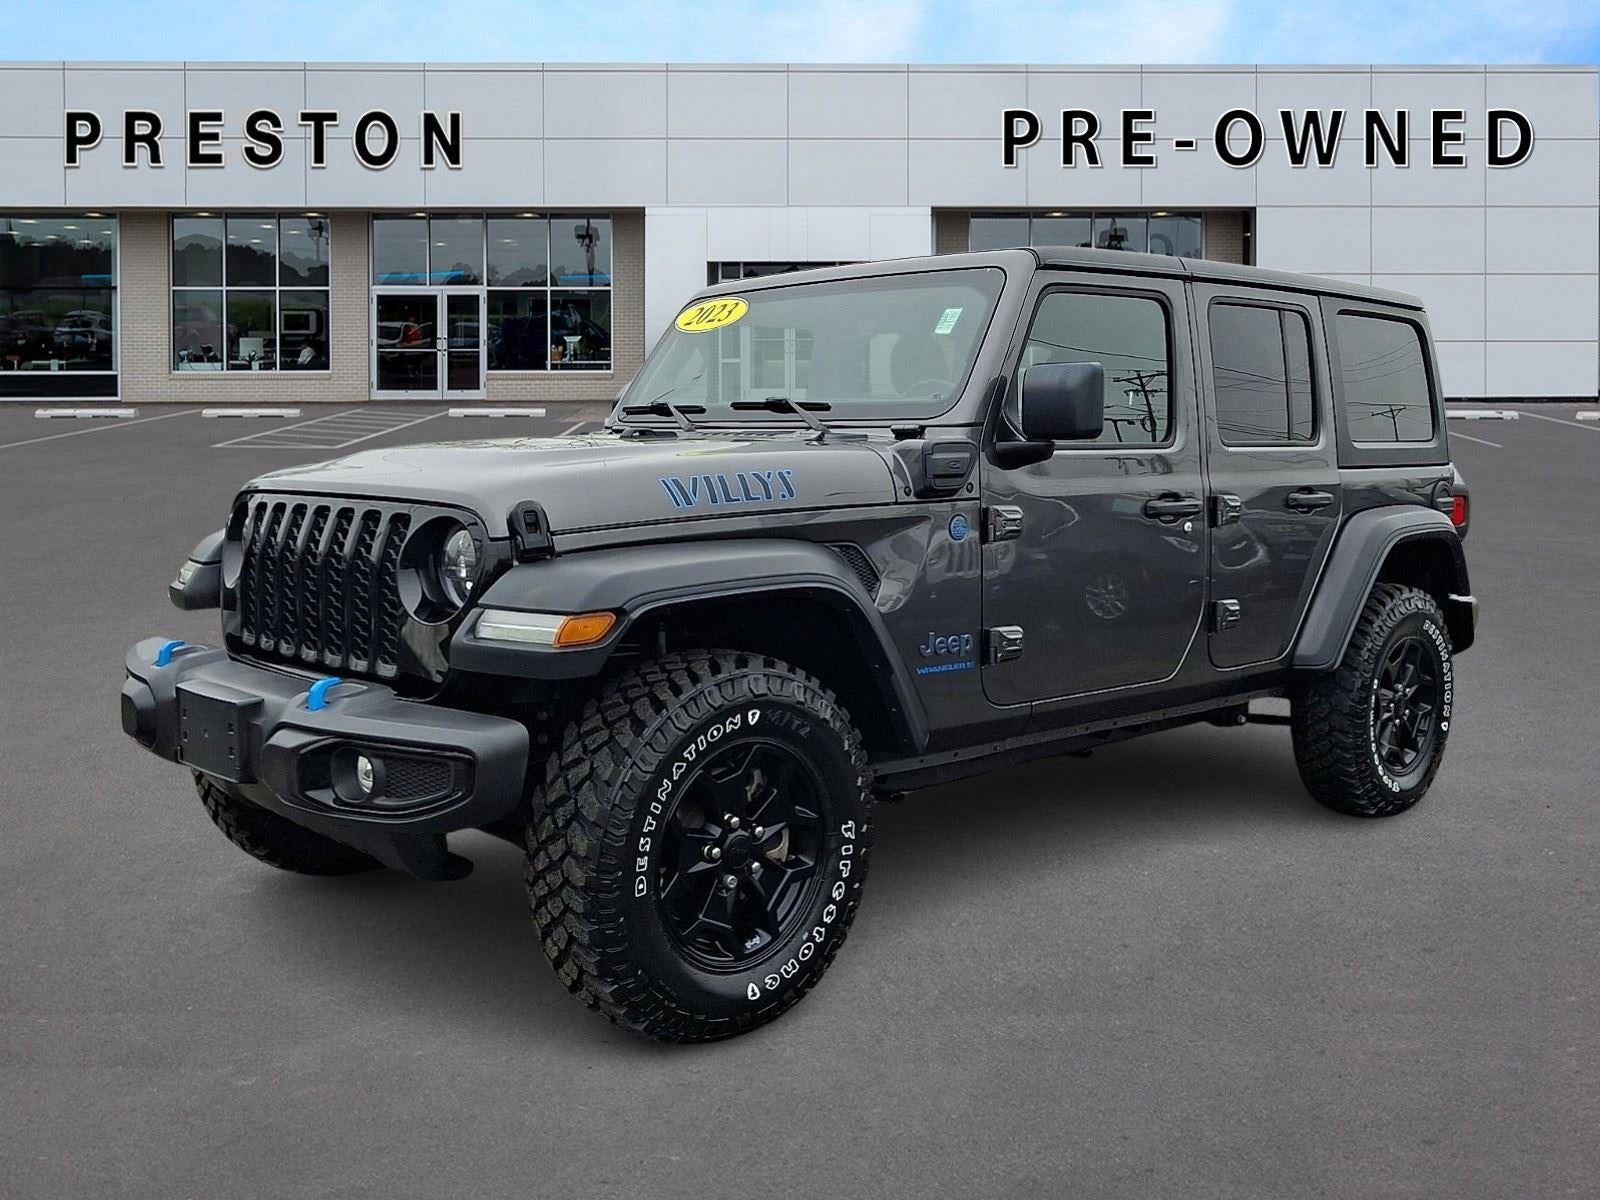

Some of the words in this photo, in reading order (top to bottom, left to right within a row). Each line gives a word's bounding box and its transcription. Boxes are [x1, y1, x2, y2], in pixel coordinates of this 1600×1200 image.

[64, 109, 463, 169] PRESTON
[1002, 108, 1535, 169] PRE-OWNED
[683, 301, 740, 326] 2023
[659, 469, 796, 507] WILLYS
[919, 631, 973, 657] Jeep
[1422, 619, 1452, 717] DESTINATION
[635, 704, 742, 897] DESTINATION
